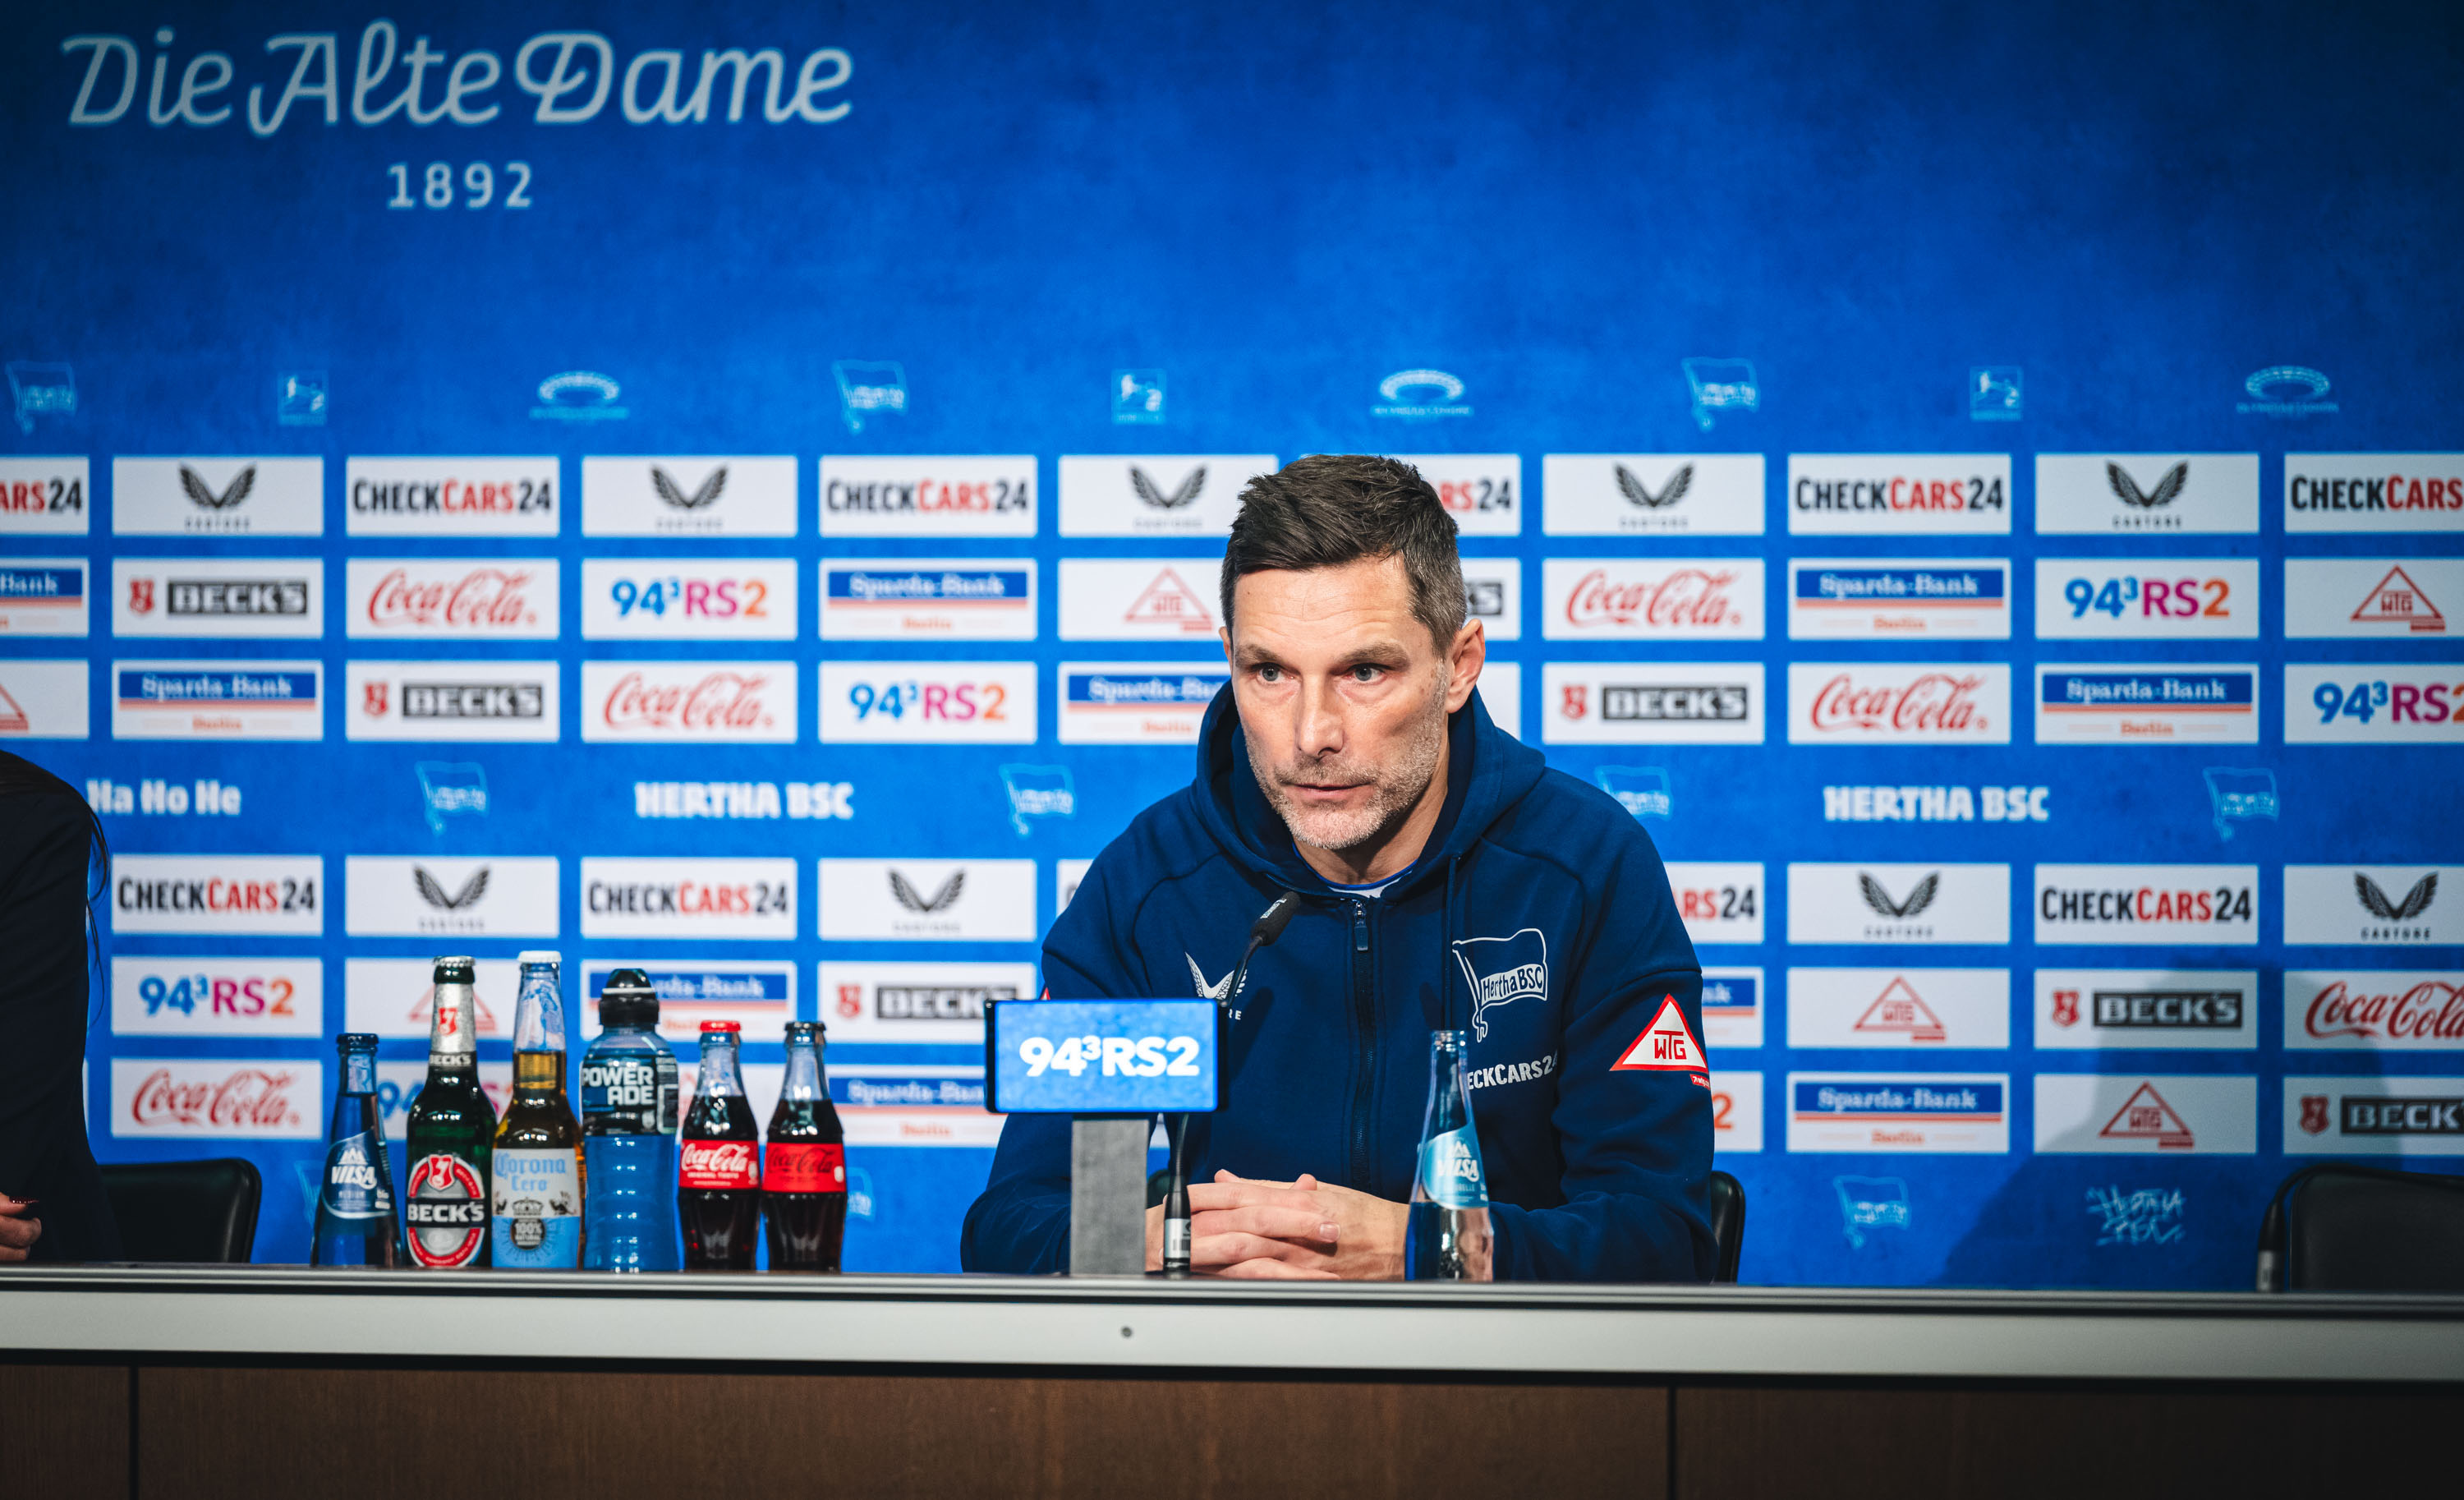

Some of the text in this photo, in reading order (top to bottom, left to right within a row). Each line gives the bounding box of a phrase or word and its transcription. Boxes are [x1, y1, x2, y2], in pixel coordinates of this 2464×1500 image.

[62, 20, 853, 136] Die Alte Dame
[386, 163, 533, 209] 1892
[354, 477, 551, 513] CHECKCARS24
[827, 477, 1027, 513] CHECKCARS24
[1796, 476, 2003, 511] CHECKCARS24
[2291, 475, 2464, 510] CHECKCARS
[171, 582, 306, 614] BECK'S
[406, 684, 542, 717] BECK'S
[1608, 686, 1747, 720] BECK'S
[86, 778, 241, 815] Ha Ho He
[635, 781, 853, 819] HERTHA BSC
[1823, 785, 2050, 821] HERTHA BSC
[118, 877, 316, 913] CHECKCARS24
[589, 879, 789, 914] CHECKCARS24
[2042, 886, 2250, 922] CHECKCARS24
[1483, 964, 1544, 1001] Hertha BSC
[2099, 989, 2239, 1026] BECK'S
[1654, 1030, 1688, 1061] WTG
[582, 1065, 655, 1088] POWER
[1467, 1049, 1557, 1090] ECKCARS2
[607, 1085, 655, 1107] ADE
[2350, 1102, 2464, 1131] BECK'
[331, 1166, 377, 1190] VILSA
[494, 1151, 566, 1178] Corona
[407, 1201, 485, 1223] BECK'S
